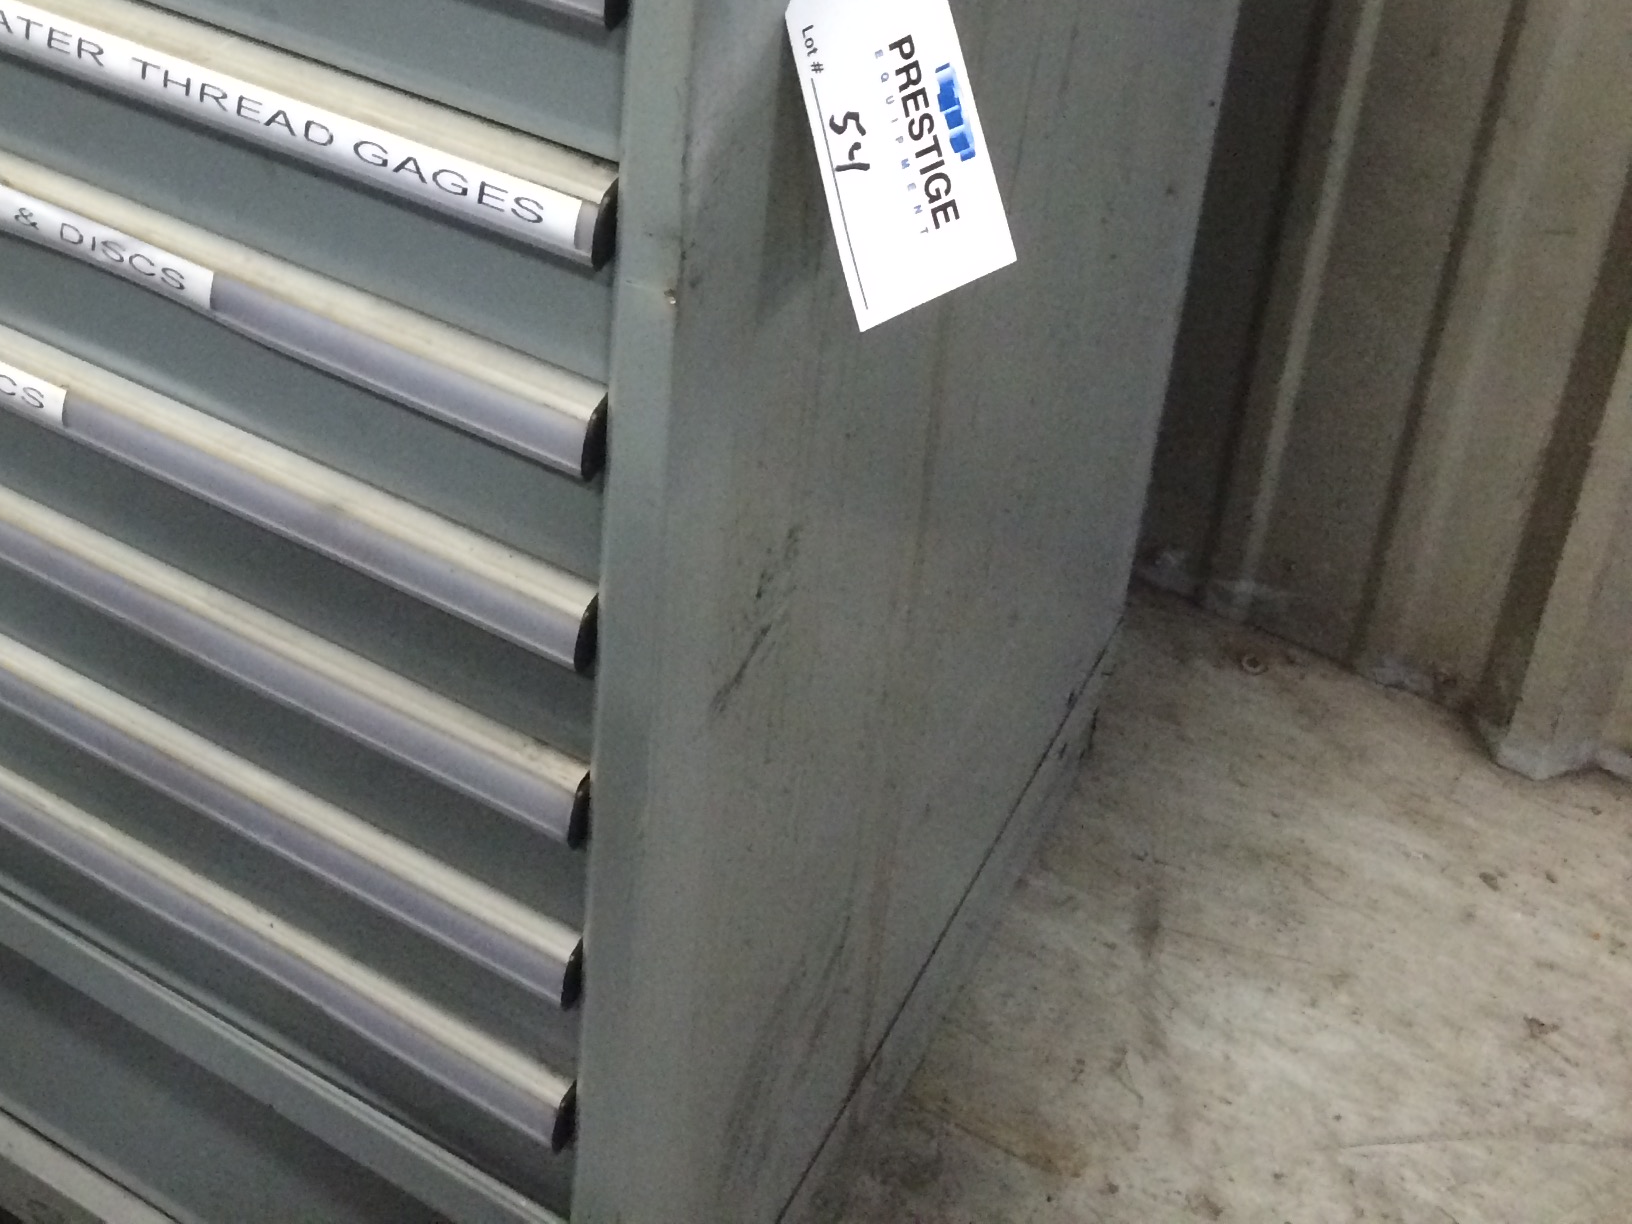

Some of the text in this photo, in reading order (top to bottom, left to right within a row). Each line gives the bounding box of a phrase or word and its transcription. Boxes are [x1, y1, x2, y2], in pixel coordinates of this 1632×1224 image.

[801, 24, 824, 75] Lot #
[131, 57, 335, 147] THREAD
[352, 140, 545, 225] GAGES
[888, 34, 960, 230] PRESTIGE
[15, 206, 40, 230] &
[59, 222, 188, 292] DISCS
